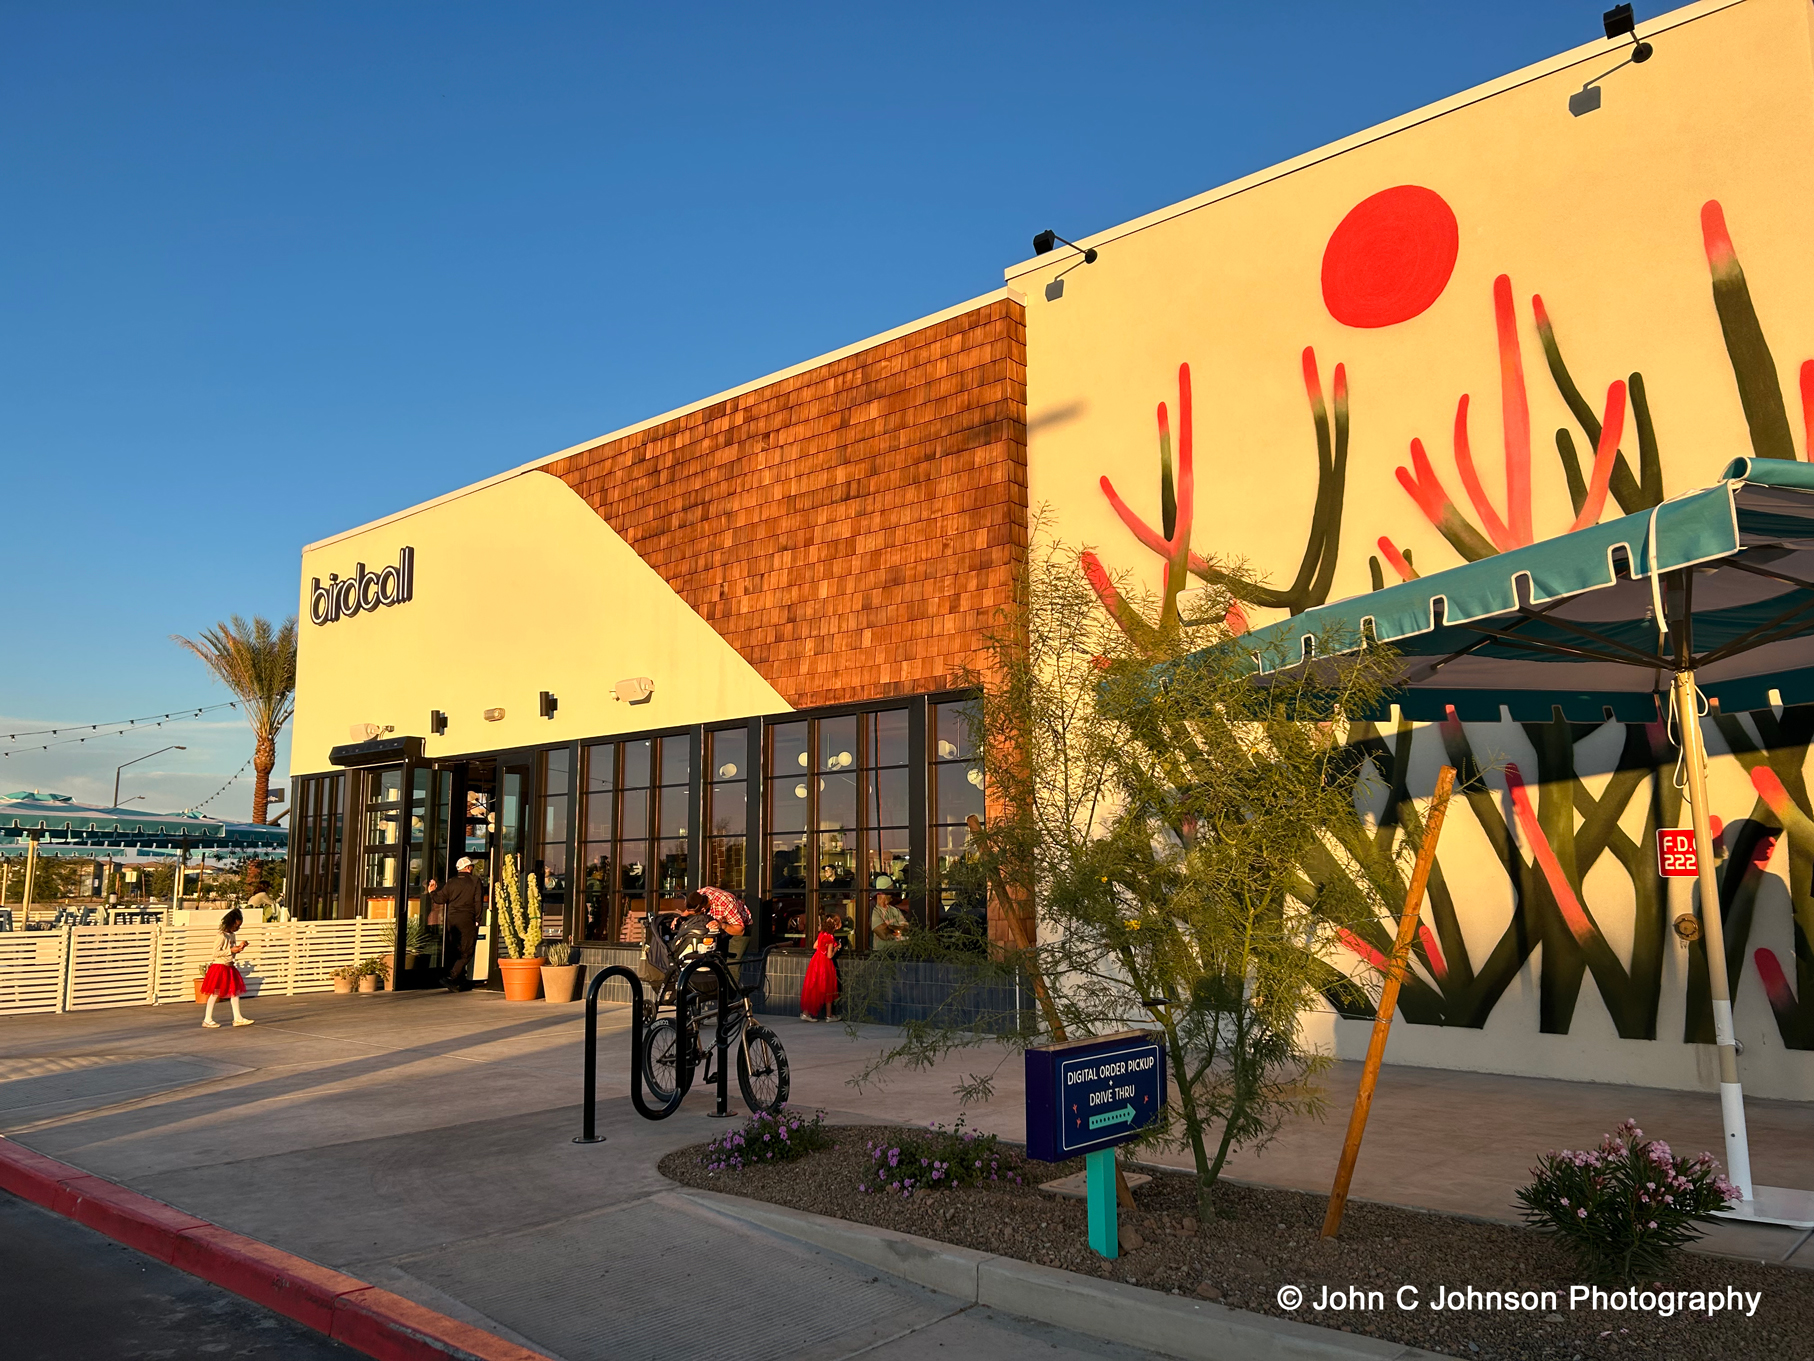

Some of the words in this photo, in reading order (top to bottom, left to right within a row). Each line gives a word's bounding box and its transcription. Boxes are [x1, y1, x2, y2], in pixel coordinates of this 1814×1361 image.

[310, 545, 415, 627] birdcall
[1663, 836, 1697, 852] F.D.
[1663, 854, 1697, 870] 222
[1067, 1067, 1098, 1086] DIGITAL
[1099, 1062, 1126, 1079] ORDER
[1127, 1056, 1155, 1073] PICKUP
[1089, 1089, 1113, 1107] DRIVE
[1114, 1084, 1136, 1101] THRU
